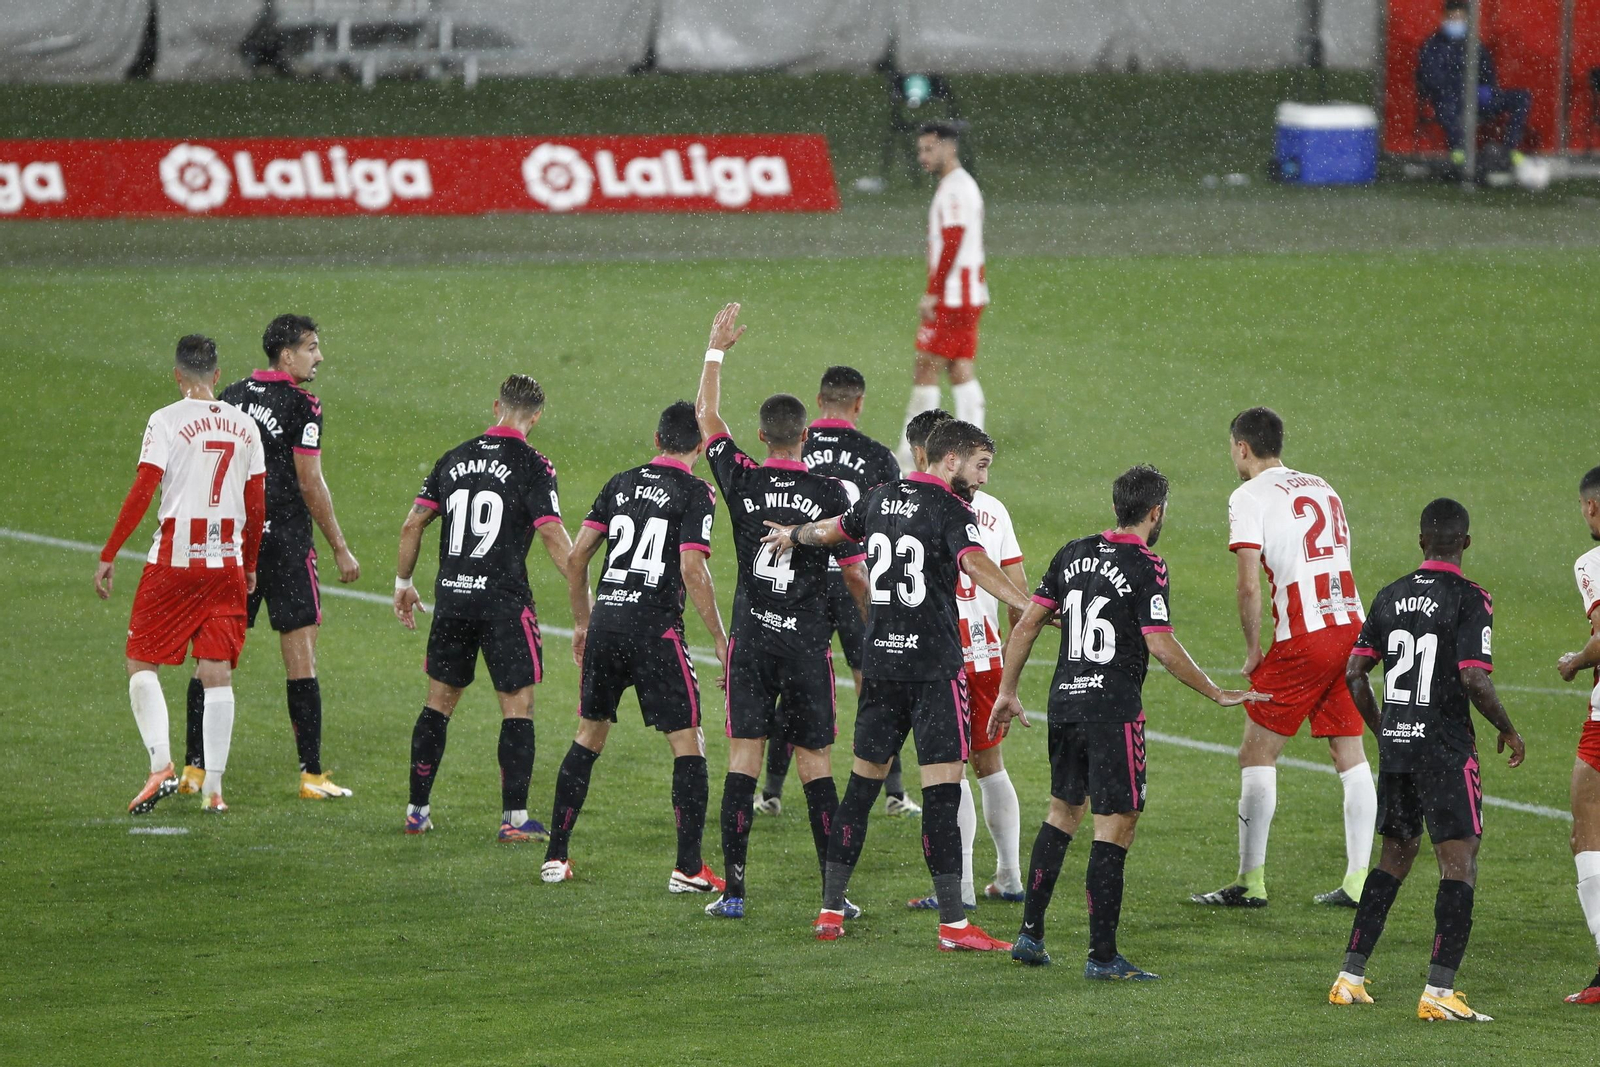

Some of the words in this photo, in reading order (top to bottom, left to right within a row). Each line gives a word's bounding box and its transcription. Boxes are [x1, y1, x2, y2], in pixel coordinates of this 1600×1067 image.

[233, 144, 433, 211] LaLiga
[594, 143, 792, 207] LaLiga
[179, 418, 212, 445] JUAN
[202, 440, 236, 507] 7
[449, 458, 487, 482] FRAN
[487, 459, 512, 484] SOL
[803, 448, 834, 469] USO
[838, 450, 866, 474] N.T.
[615, 491, 630, 507] R.
[634, 485, 671, 509] FOLCH
[743, 498, 761, 513] B.
[765, 492, 823, 521] WILSON
[1274, 483, 1291, 495] J.
[446, 488, 504, 558] 19
[1291, 495, 1350, 563] 24
[602, 514, 669, 588] 24
[753, 527, 795, 594] 4
[457, 573, 474, 582] Islas
[867, 532, 927, 608] 23
[1063, 557, 1100, 584] AITOR
[1100, 560, 1133, 598] SANZ
[1395, 596, 1439, 618] MOORE
[888, 632, 905, 641] Islas
[1062, 589, 1116, 665] 16
[1384, 629, 1438, 707] 21
[1382, 728, 1411, 738] Canarias
[1396, 722, 1412, 730] Islas
